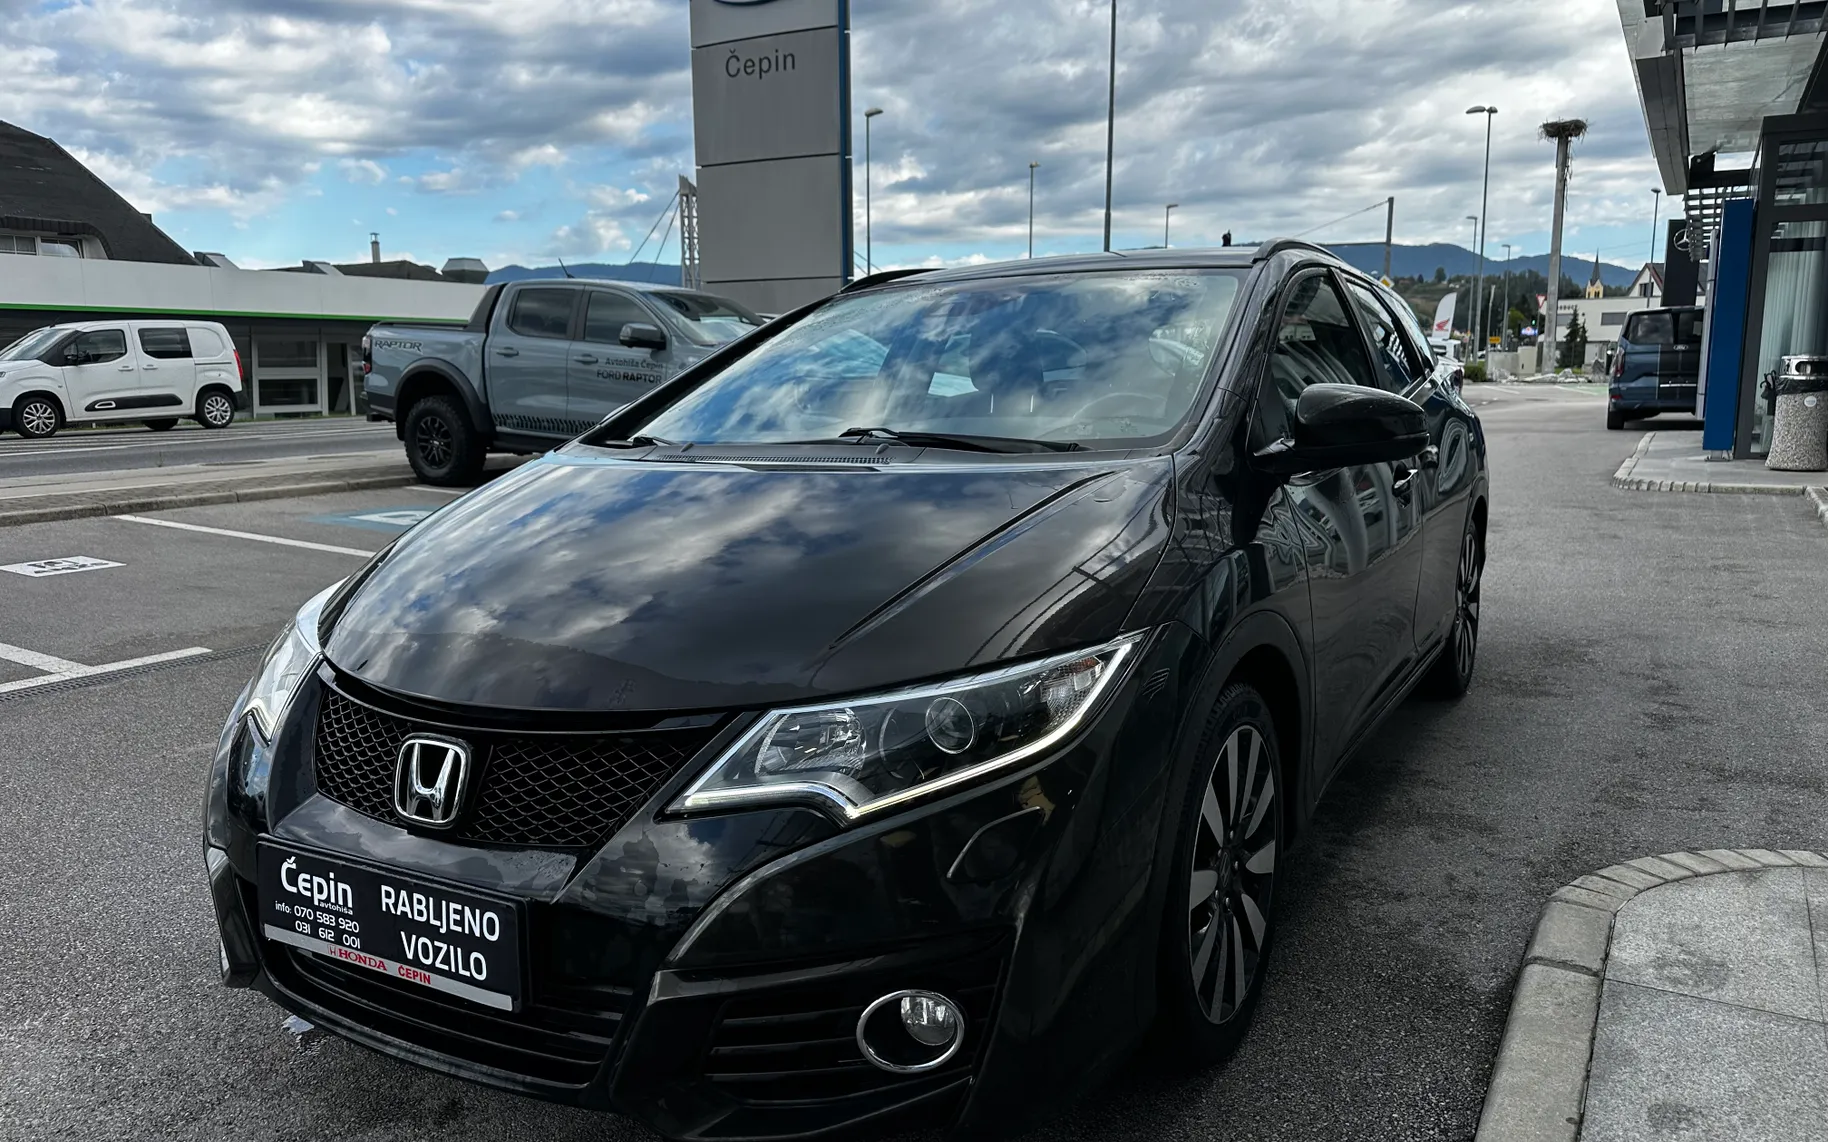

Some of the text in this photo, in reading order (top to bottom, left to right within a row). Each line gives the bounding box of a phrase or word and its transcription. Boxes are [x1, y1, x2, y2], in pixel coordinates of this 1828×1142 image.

[725, 49, 796, 80] Čepin
[374, 340, 423, 353] RAPTOR
[597, 370, 662, 384] FORD RAPTOR
[281, 856, 353, 908] Čepin
[275, 900, 360, 933] info: 070 583 920
[381, 885, 500, 941] RABLJENO
[295, 920, 361, 949] 031 612 001
[338, 948, 387, 971] HONDA
[400, 931, 487, 981] VOZILO
